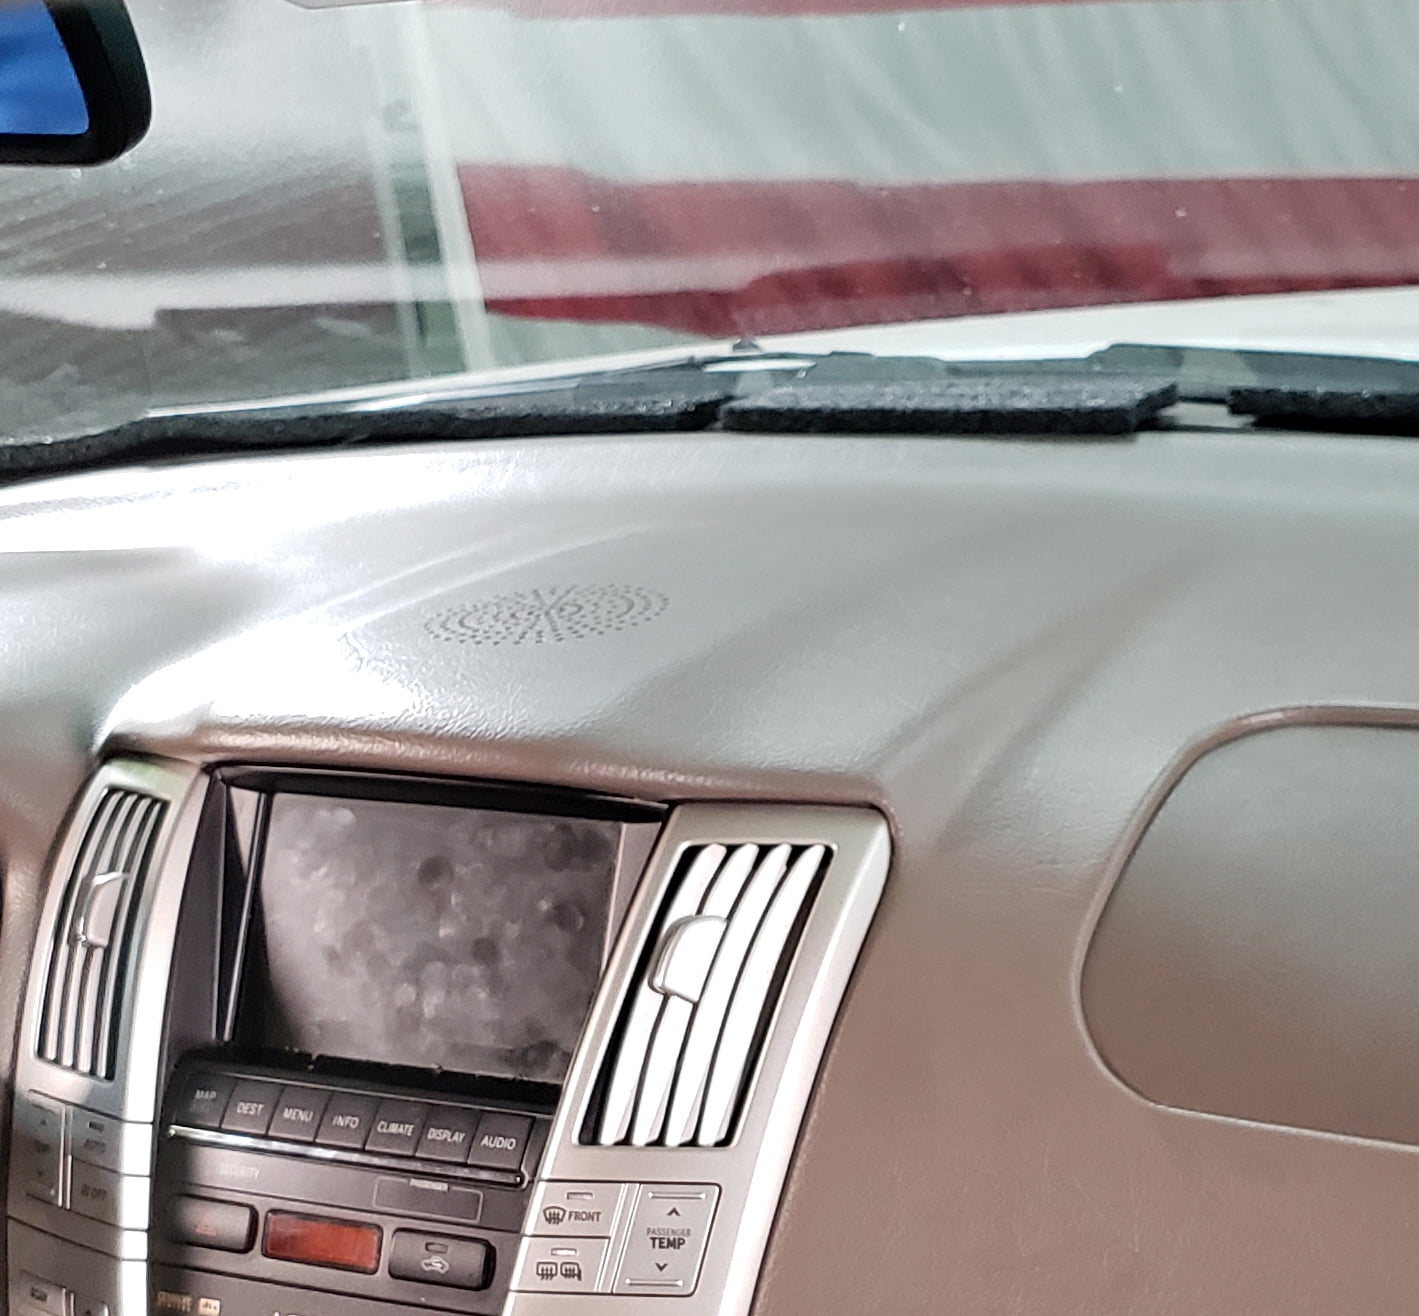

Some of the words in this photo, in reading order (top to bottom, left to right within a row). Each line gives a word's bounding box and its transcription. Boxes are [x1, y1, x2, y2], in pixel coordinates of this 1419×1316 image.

[237, 1102, 265, 1116] DEST
[283, 1107, 314, 1122] MENU
[332, 1115, 360, 1130] INFO
[377, 1120, 415, 1137] CLIMATE
[427, 1127, 466, 1144] DISPLAY
[481, 1134, 517, 1151] AUDIO
[568, 1210, 602, 1223] FRONT
[650, 1237, 686, 1251] TEMP
